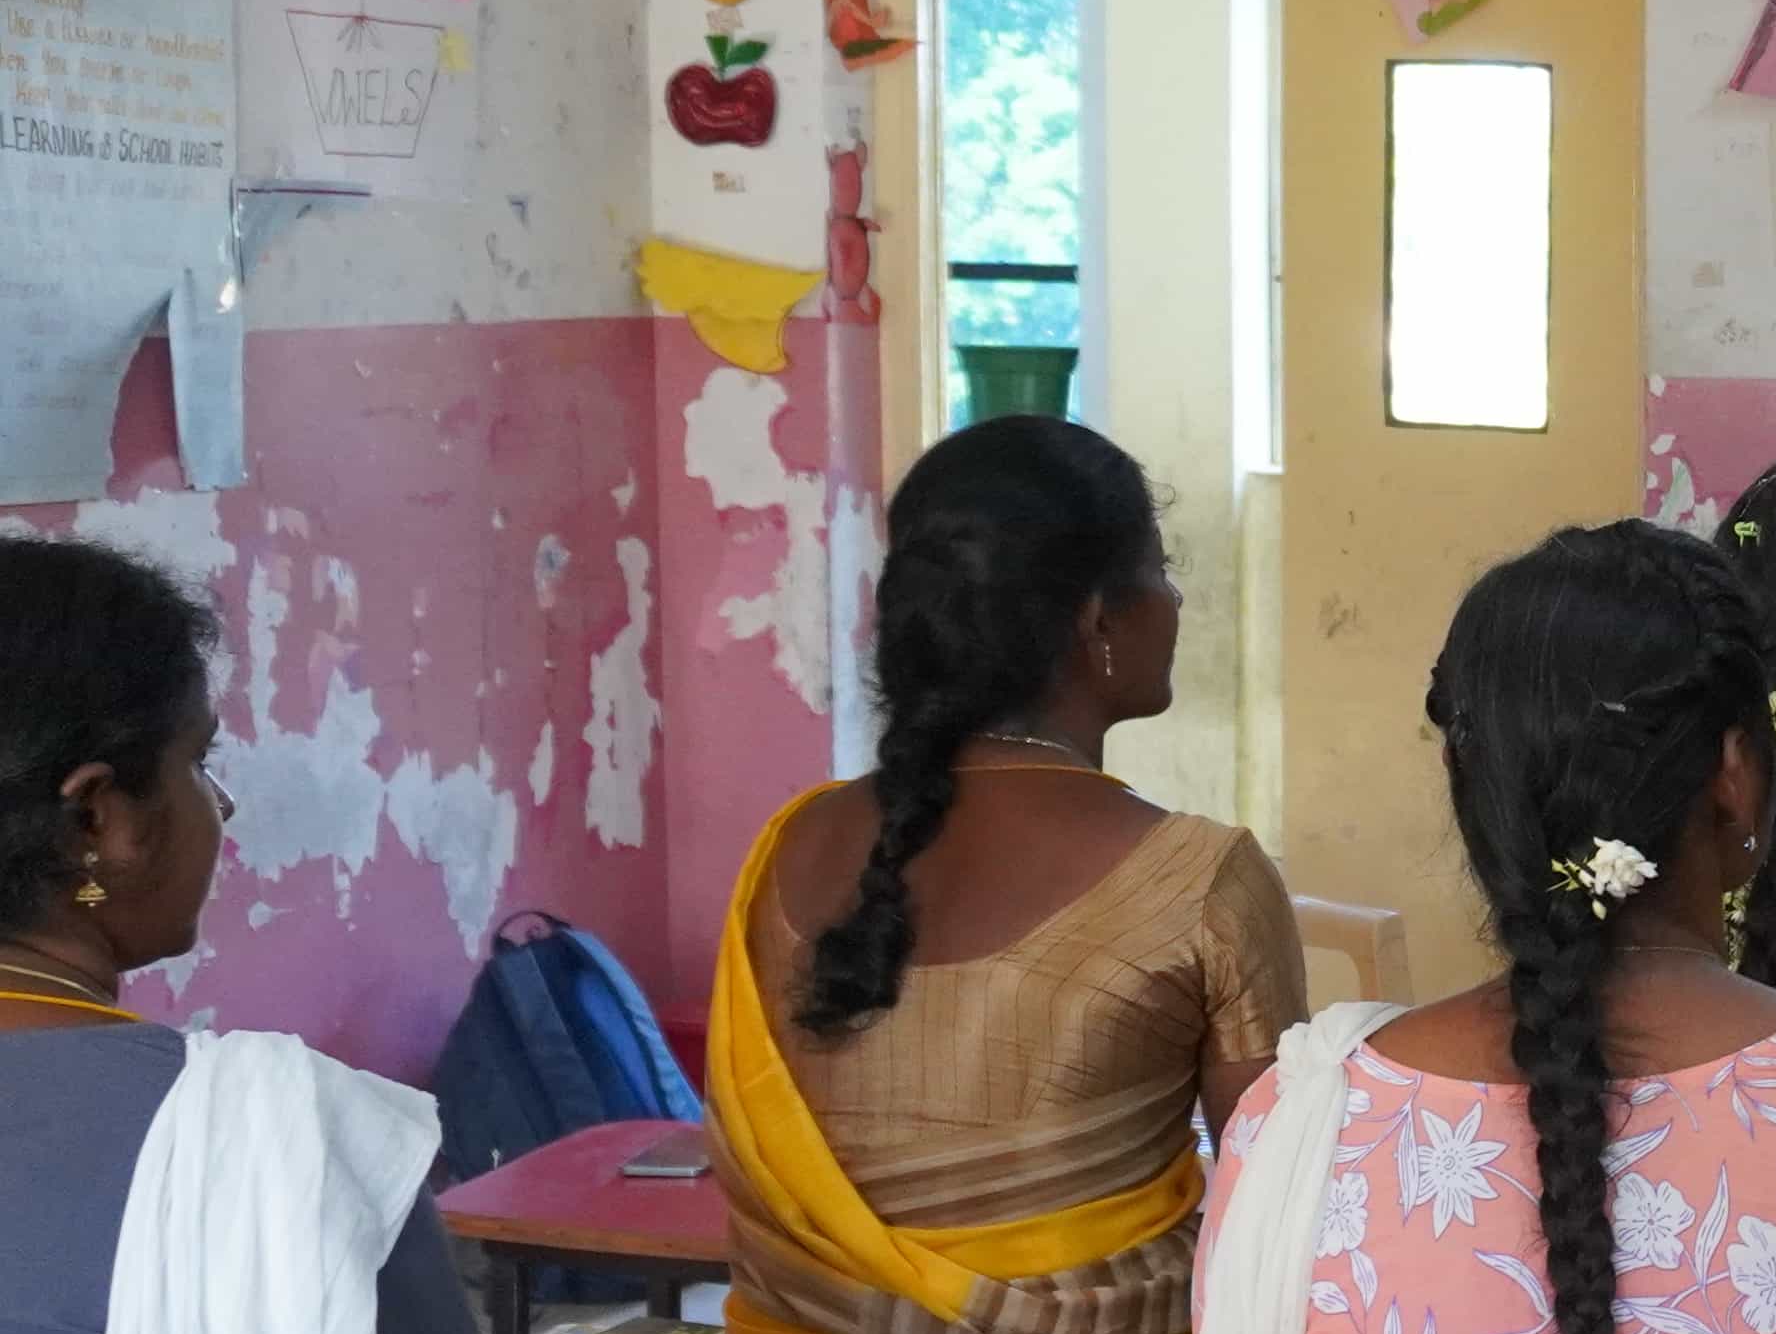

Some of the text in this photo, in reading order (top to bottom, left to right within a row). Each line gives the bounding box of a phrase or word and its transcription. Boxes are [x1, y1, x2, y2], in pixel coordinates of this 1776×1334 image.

[310, 66, 426, 128] VOWELS
[0, 112, 94, 158] LEARNING
[119, 127, 174, 165] SCHOOL
[179, 138, 224, 168] HABITS
